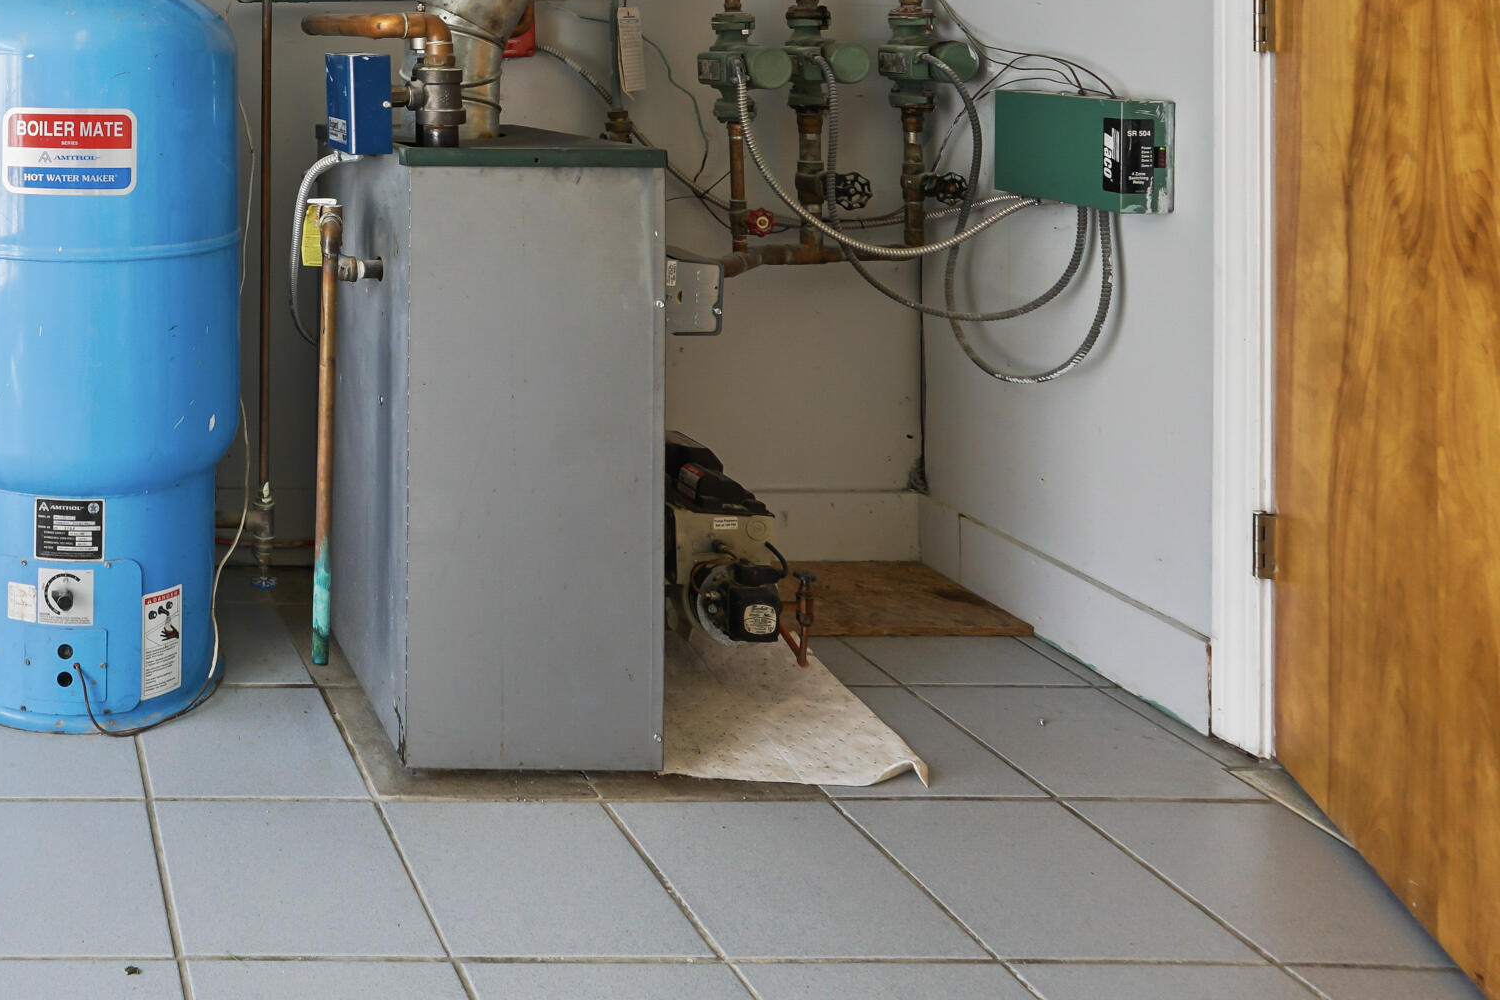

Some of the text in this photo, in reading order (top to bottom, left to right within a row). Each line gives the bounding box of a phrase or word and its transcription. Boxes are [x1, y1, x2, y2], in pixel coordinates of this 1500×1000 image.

[16, 120, 124, 137] BOILER MATE
[24, 173, 115, 183] HOT WATER MAKER
[153, 591, 179, 603] DANGER
